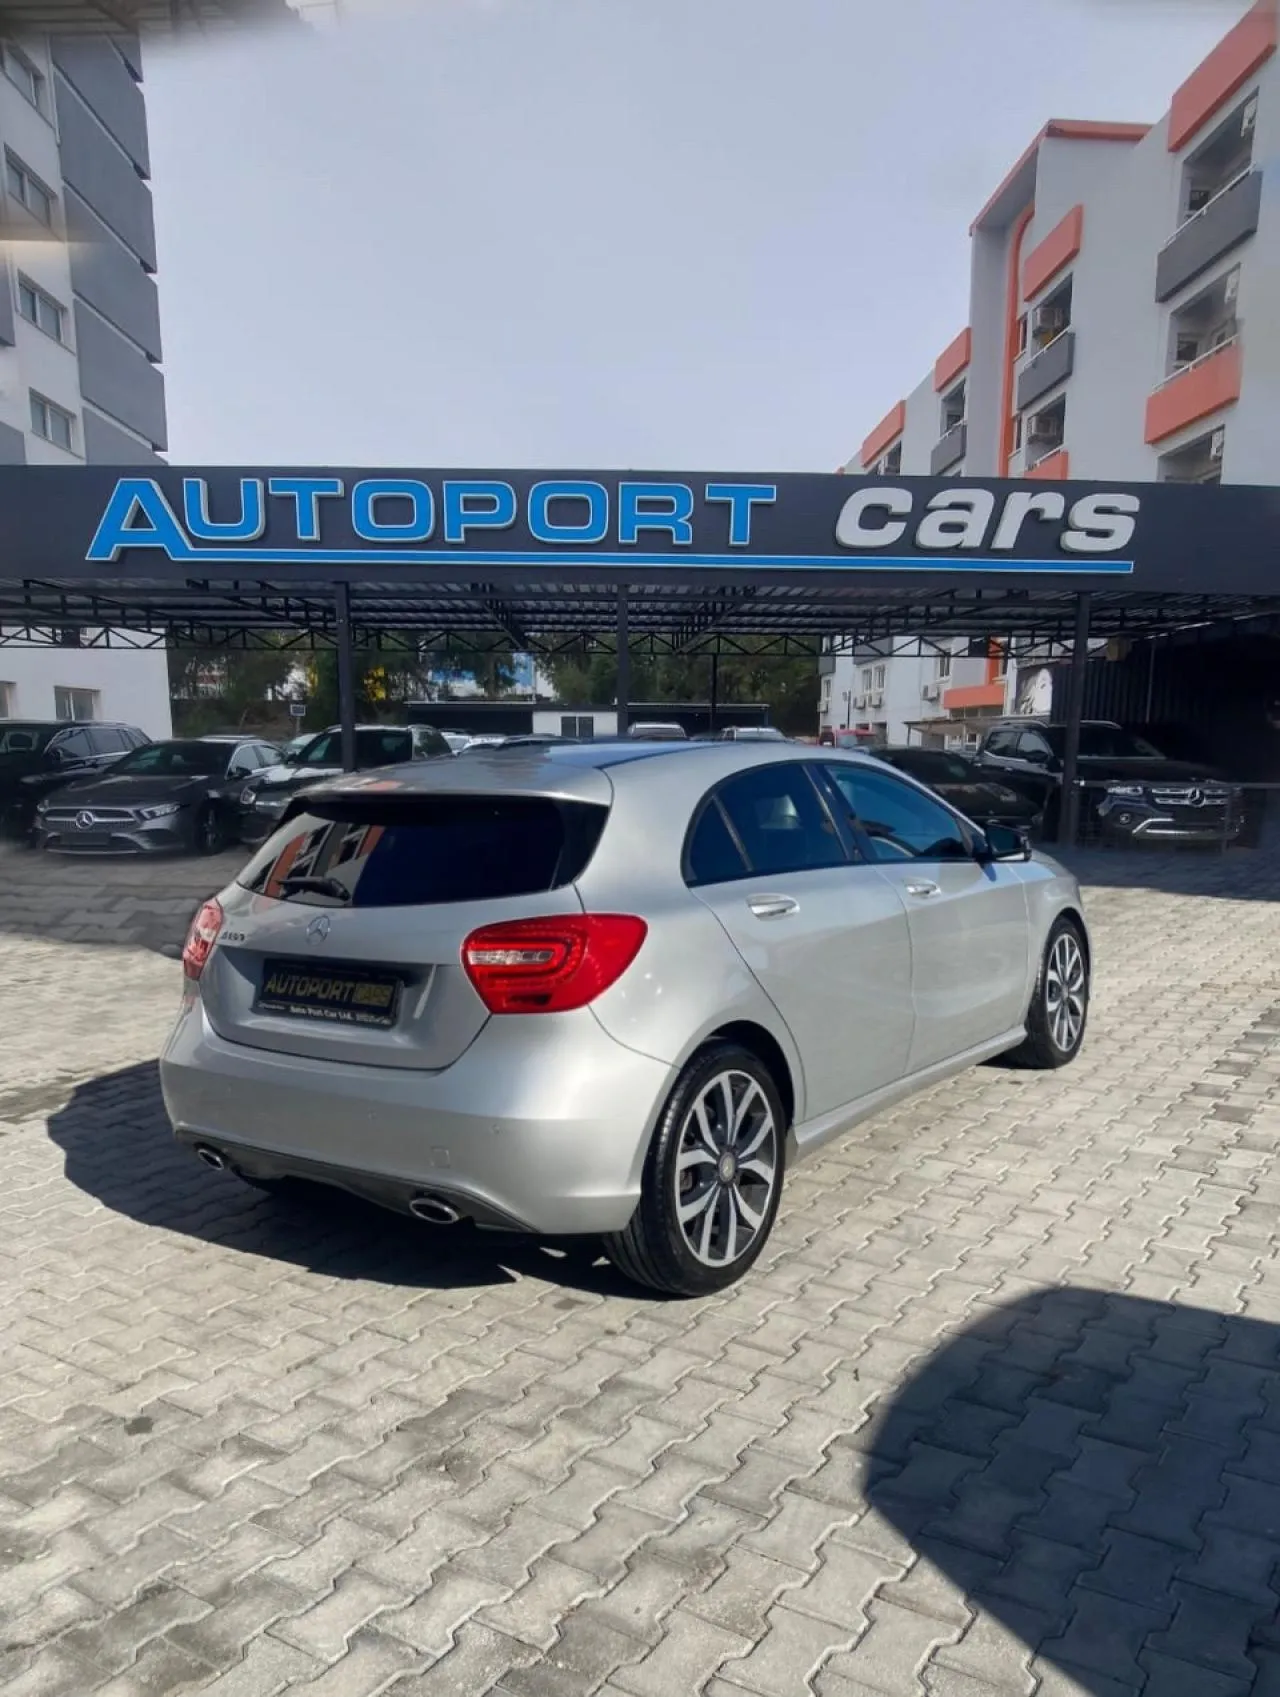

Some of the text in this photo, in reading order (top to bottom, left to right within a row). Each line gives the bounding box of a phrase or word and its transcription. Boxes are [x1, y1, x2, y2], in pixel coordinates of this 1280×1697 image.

[85, 477, 1141, 562] AUTOPORT cars
[264, 972, 355, 1003] AUTOPORT
